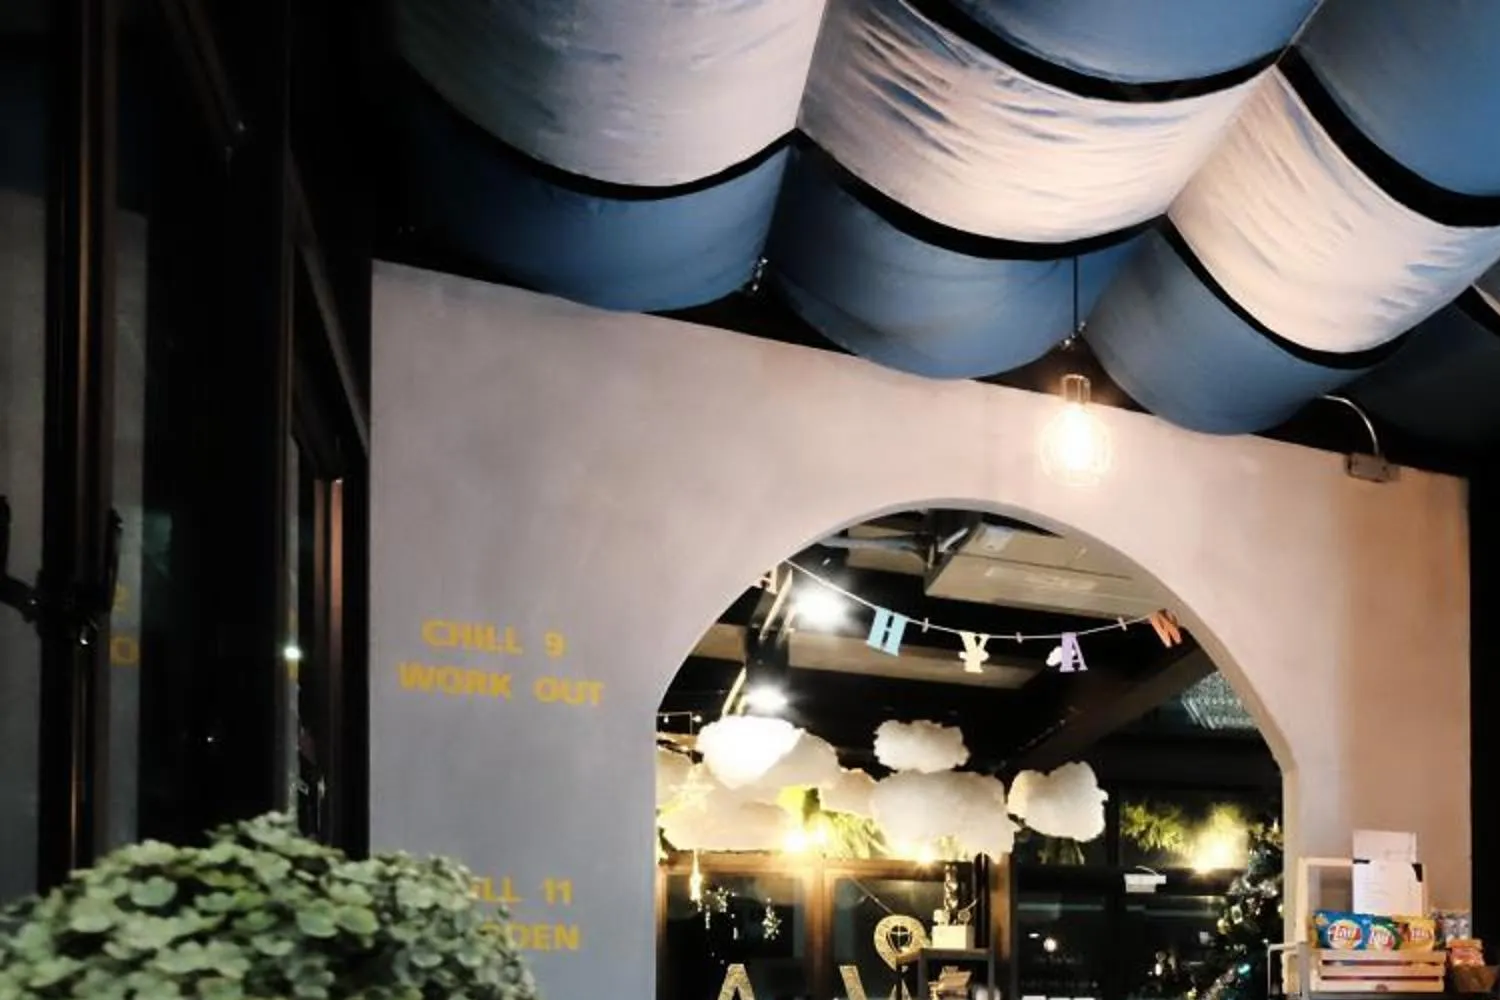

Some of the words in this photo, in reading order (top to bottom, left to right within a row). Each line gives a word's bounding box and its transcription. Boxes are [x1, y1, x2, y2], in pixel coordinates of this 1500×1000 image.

[421, 619, 523, 655] CHILL
[544, 631, 566, 658] 9
[397, 661, 512, 698] WORK
[533, 675, 605, 706] OUT
[541, 877, 573, 906] 11
